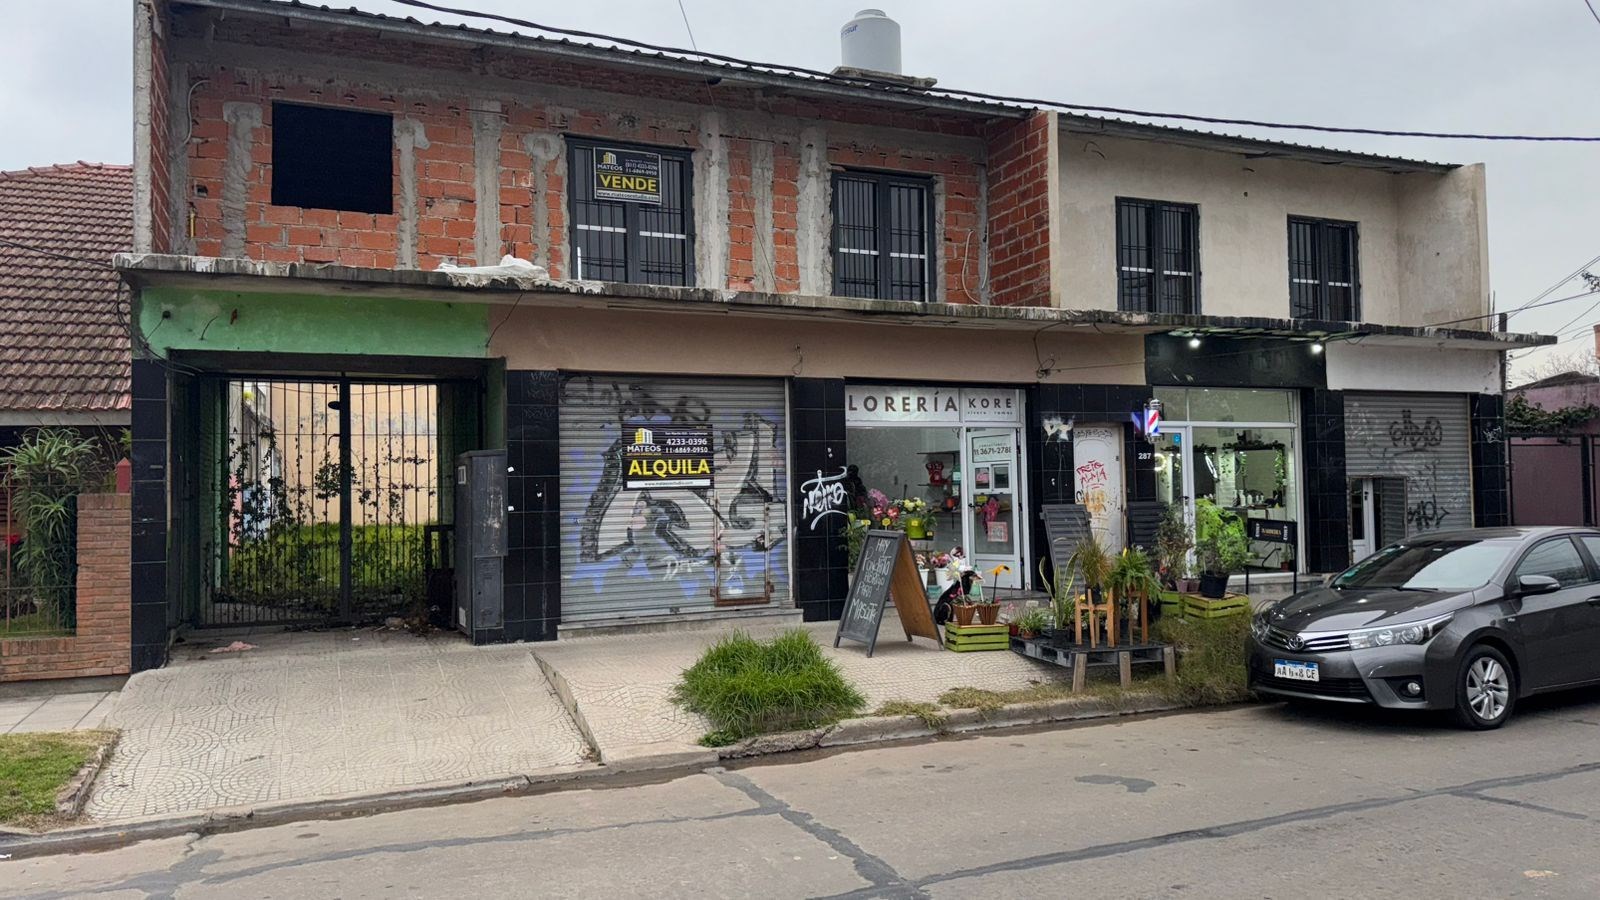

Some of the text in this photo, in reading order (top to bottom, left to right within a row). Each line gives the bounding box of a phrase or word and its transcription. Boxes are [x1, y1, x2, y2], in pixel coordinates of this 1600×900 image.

[600, 175, 656, 192] VENDE
[969, 398, 1012, 409] KORE
[666, 438, 708, 446] 4233-0396
[627, 445, 661, 453] MATEOS
[665, 446, 708, 454] 11-6869-0950
[1138, 452, 1151, 460] 287
[628, 459, 710, 478] ALQUILA
